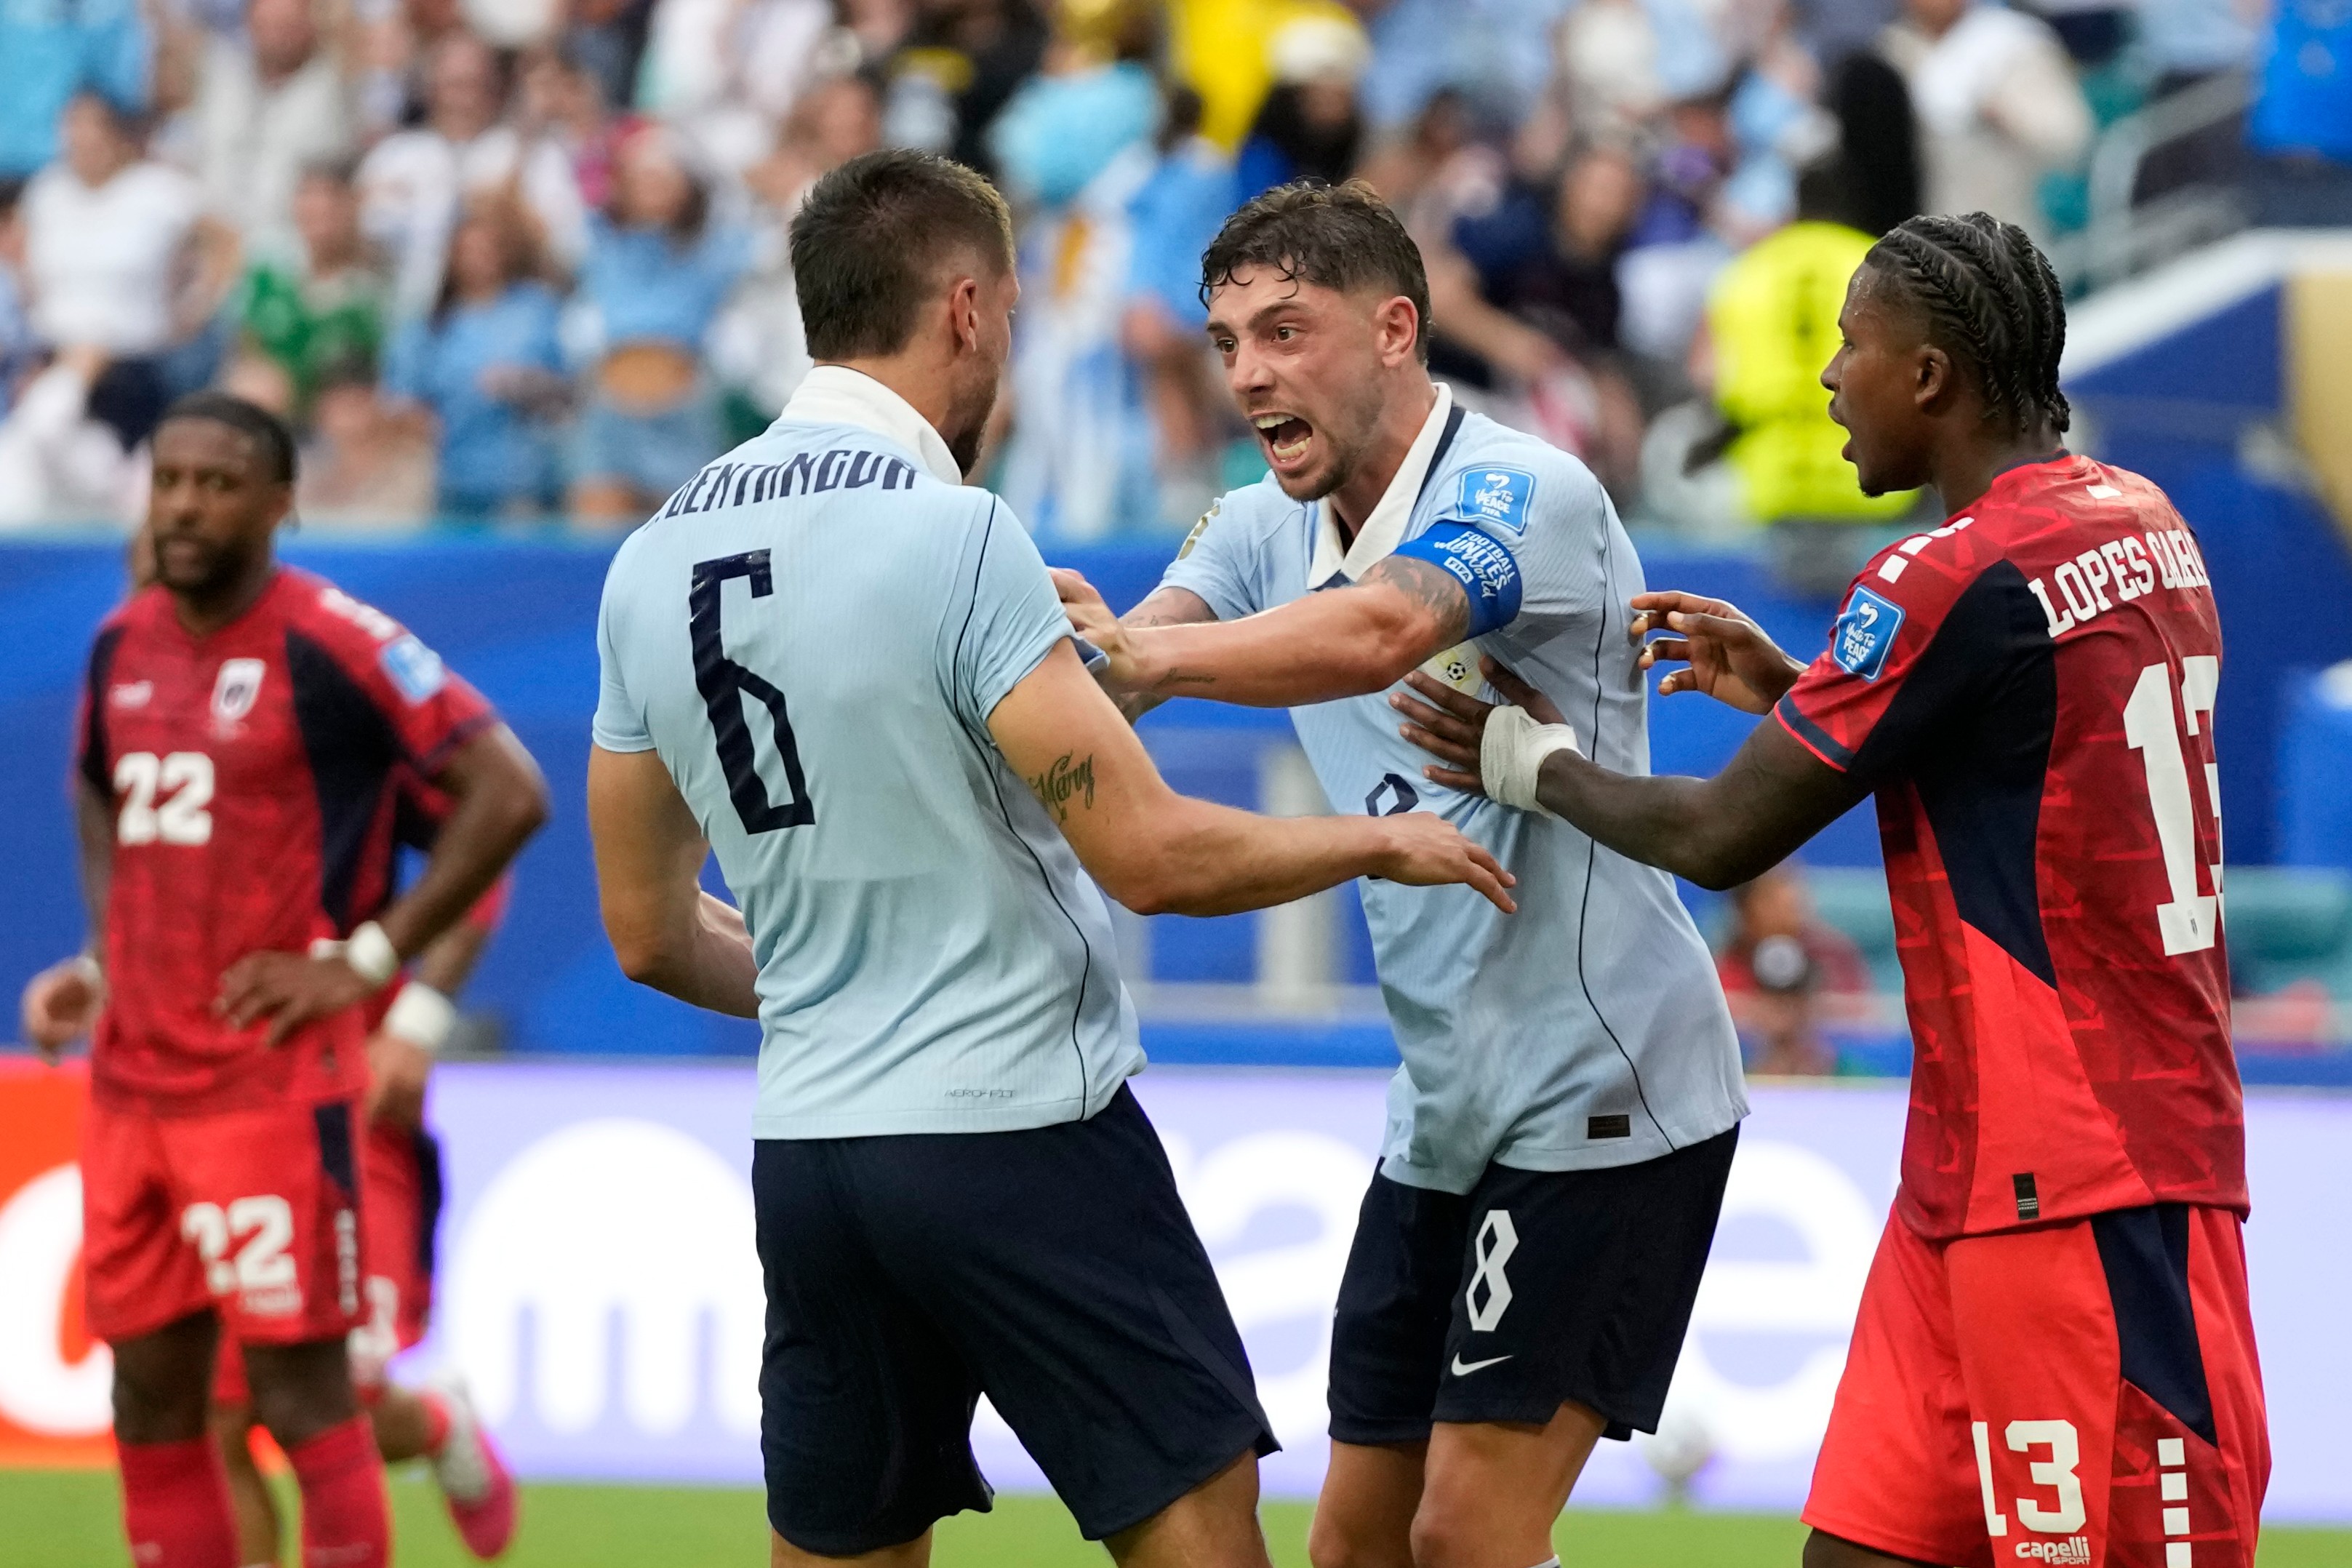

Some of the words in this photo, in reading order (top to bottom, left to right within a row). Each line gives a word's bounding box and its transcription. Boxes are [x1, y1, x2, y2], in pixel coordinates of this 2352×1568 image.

[1476, 496, 1511, 514] PEACE
[1447, 559, 1471, 582] FIFA
[1450, 537, 1508, 591] UNITES
[1460, 530, 1516, 583] FOOTBALL
[2028, 535, 2155, 638] LOPES
[689, 548, 816, 836] 6
[113, 750, 215, 847] 22
[180, 1194, 296, 1297] 22
[1465, 1209, 1519, 1332] 8
[1972, 1419, 2087, 1537] 13
[2015, 1536, 2091, 1563] capelli
[2052, 1556, 2092, 1566] SPORT
